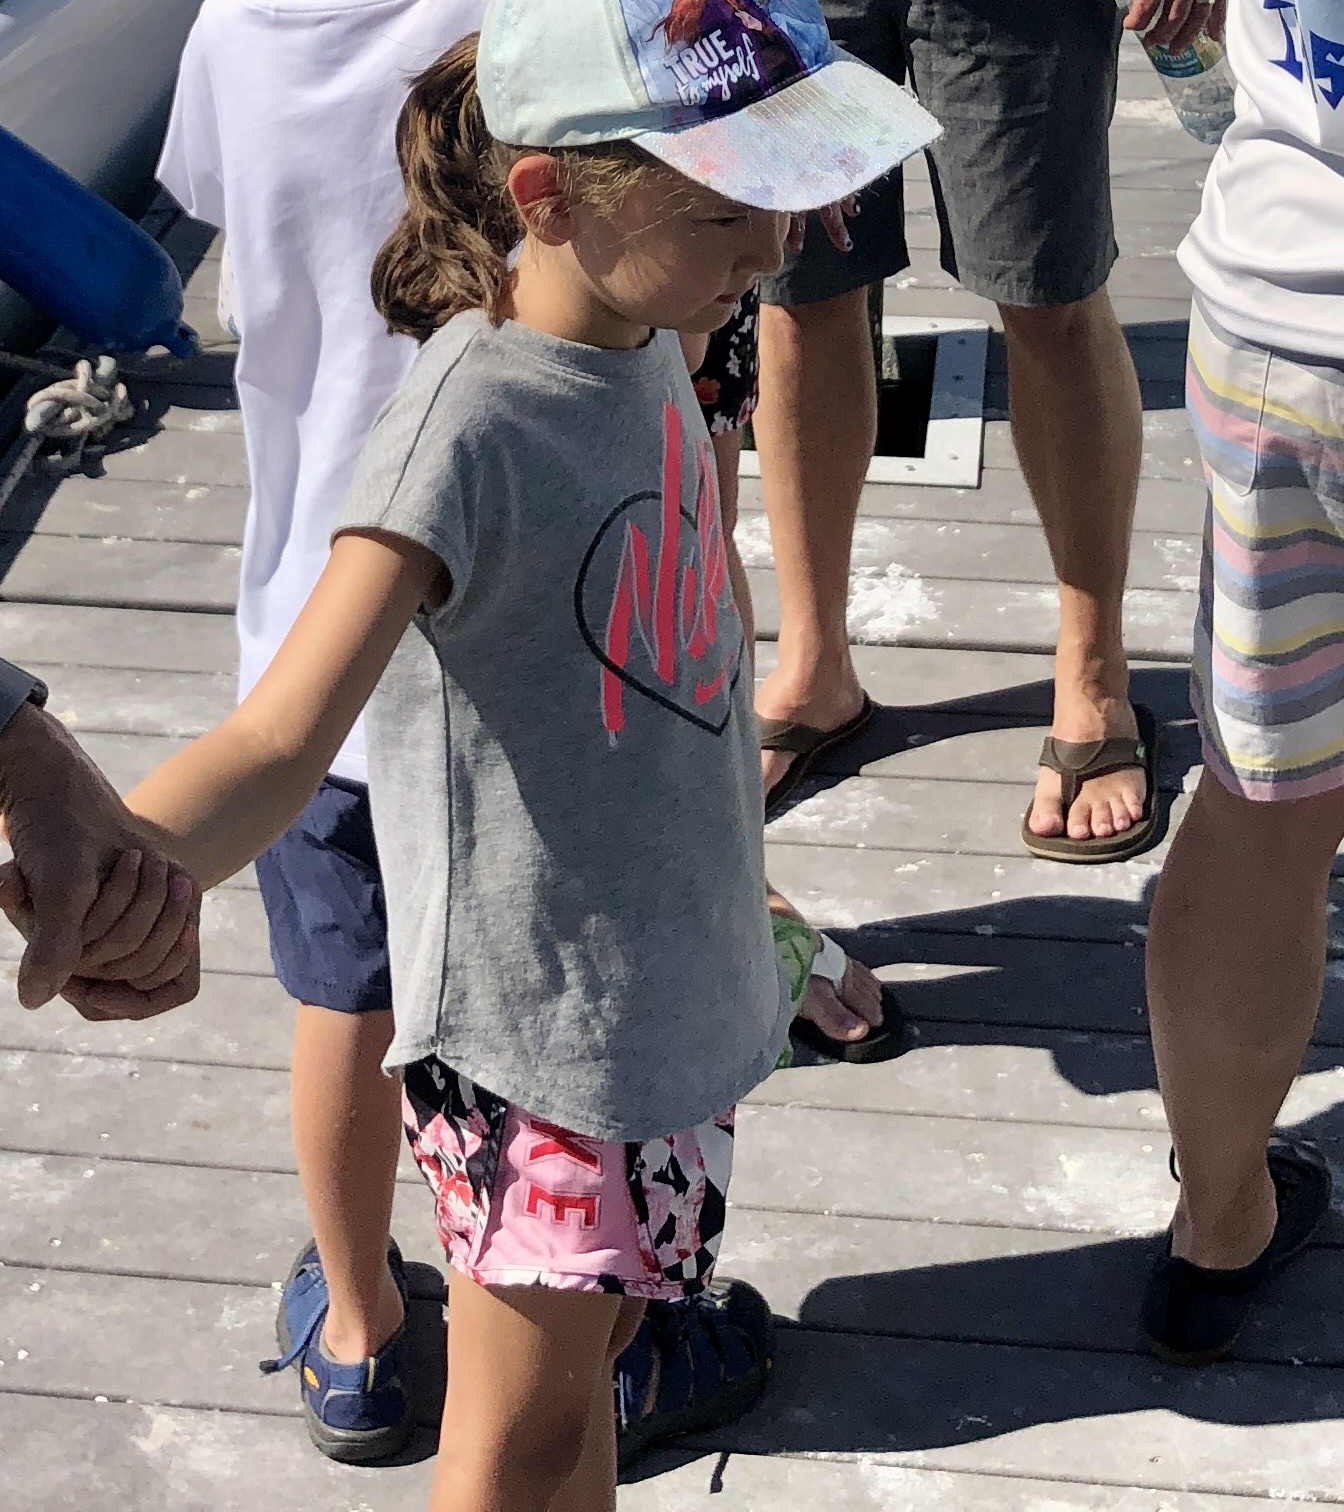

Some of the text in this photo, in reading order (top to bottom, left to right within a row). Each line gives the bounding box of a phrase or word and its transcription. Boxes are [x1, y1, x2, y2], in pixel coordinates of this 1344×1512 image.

[663, 29, 734, 85] TRUE
[676, 32, 761, 106] to myself
